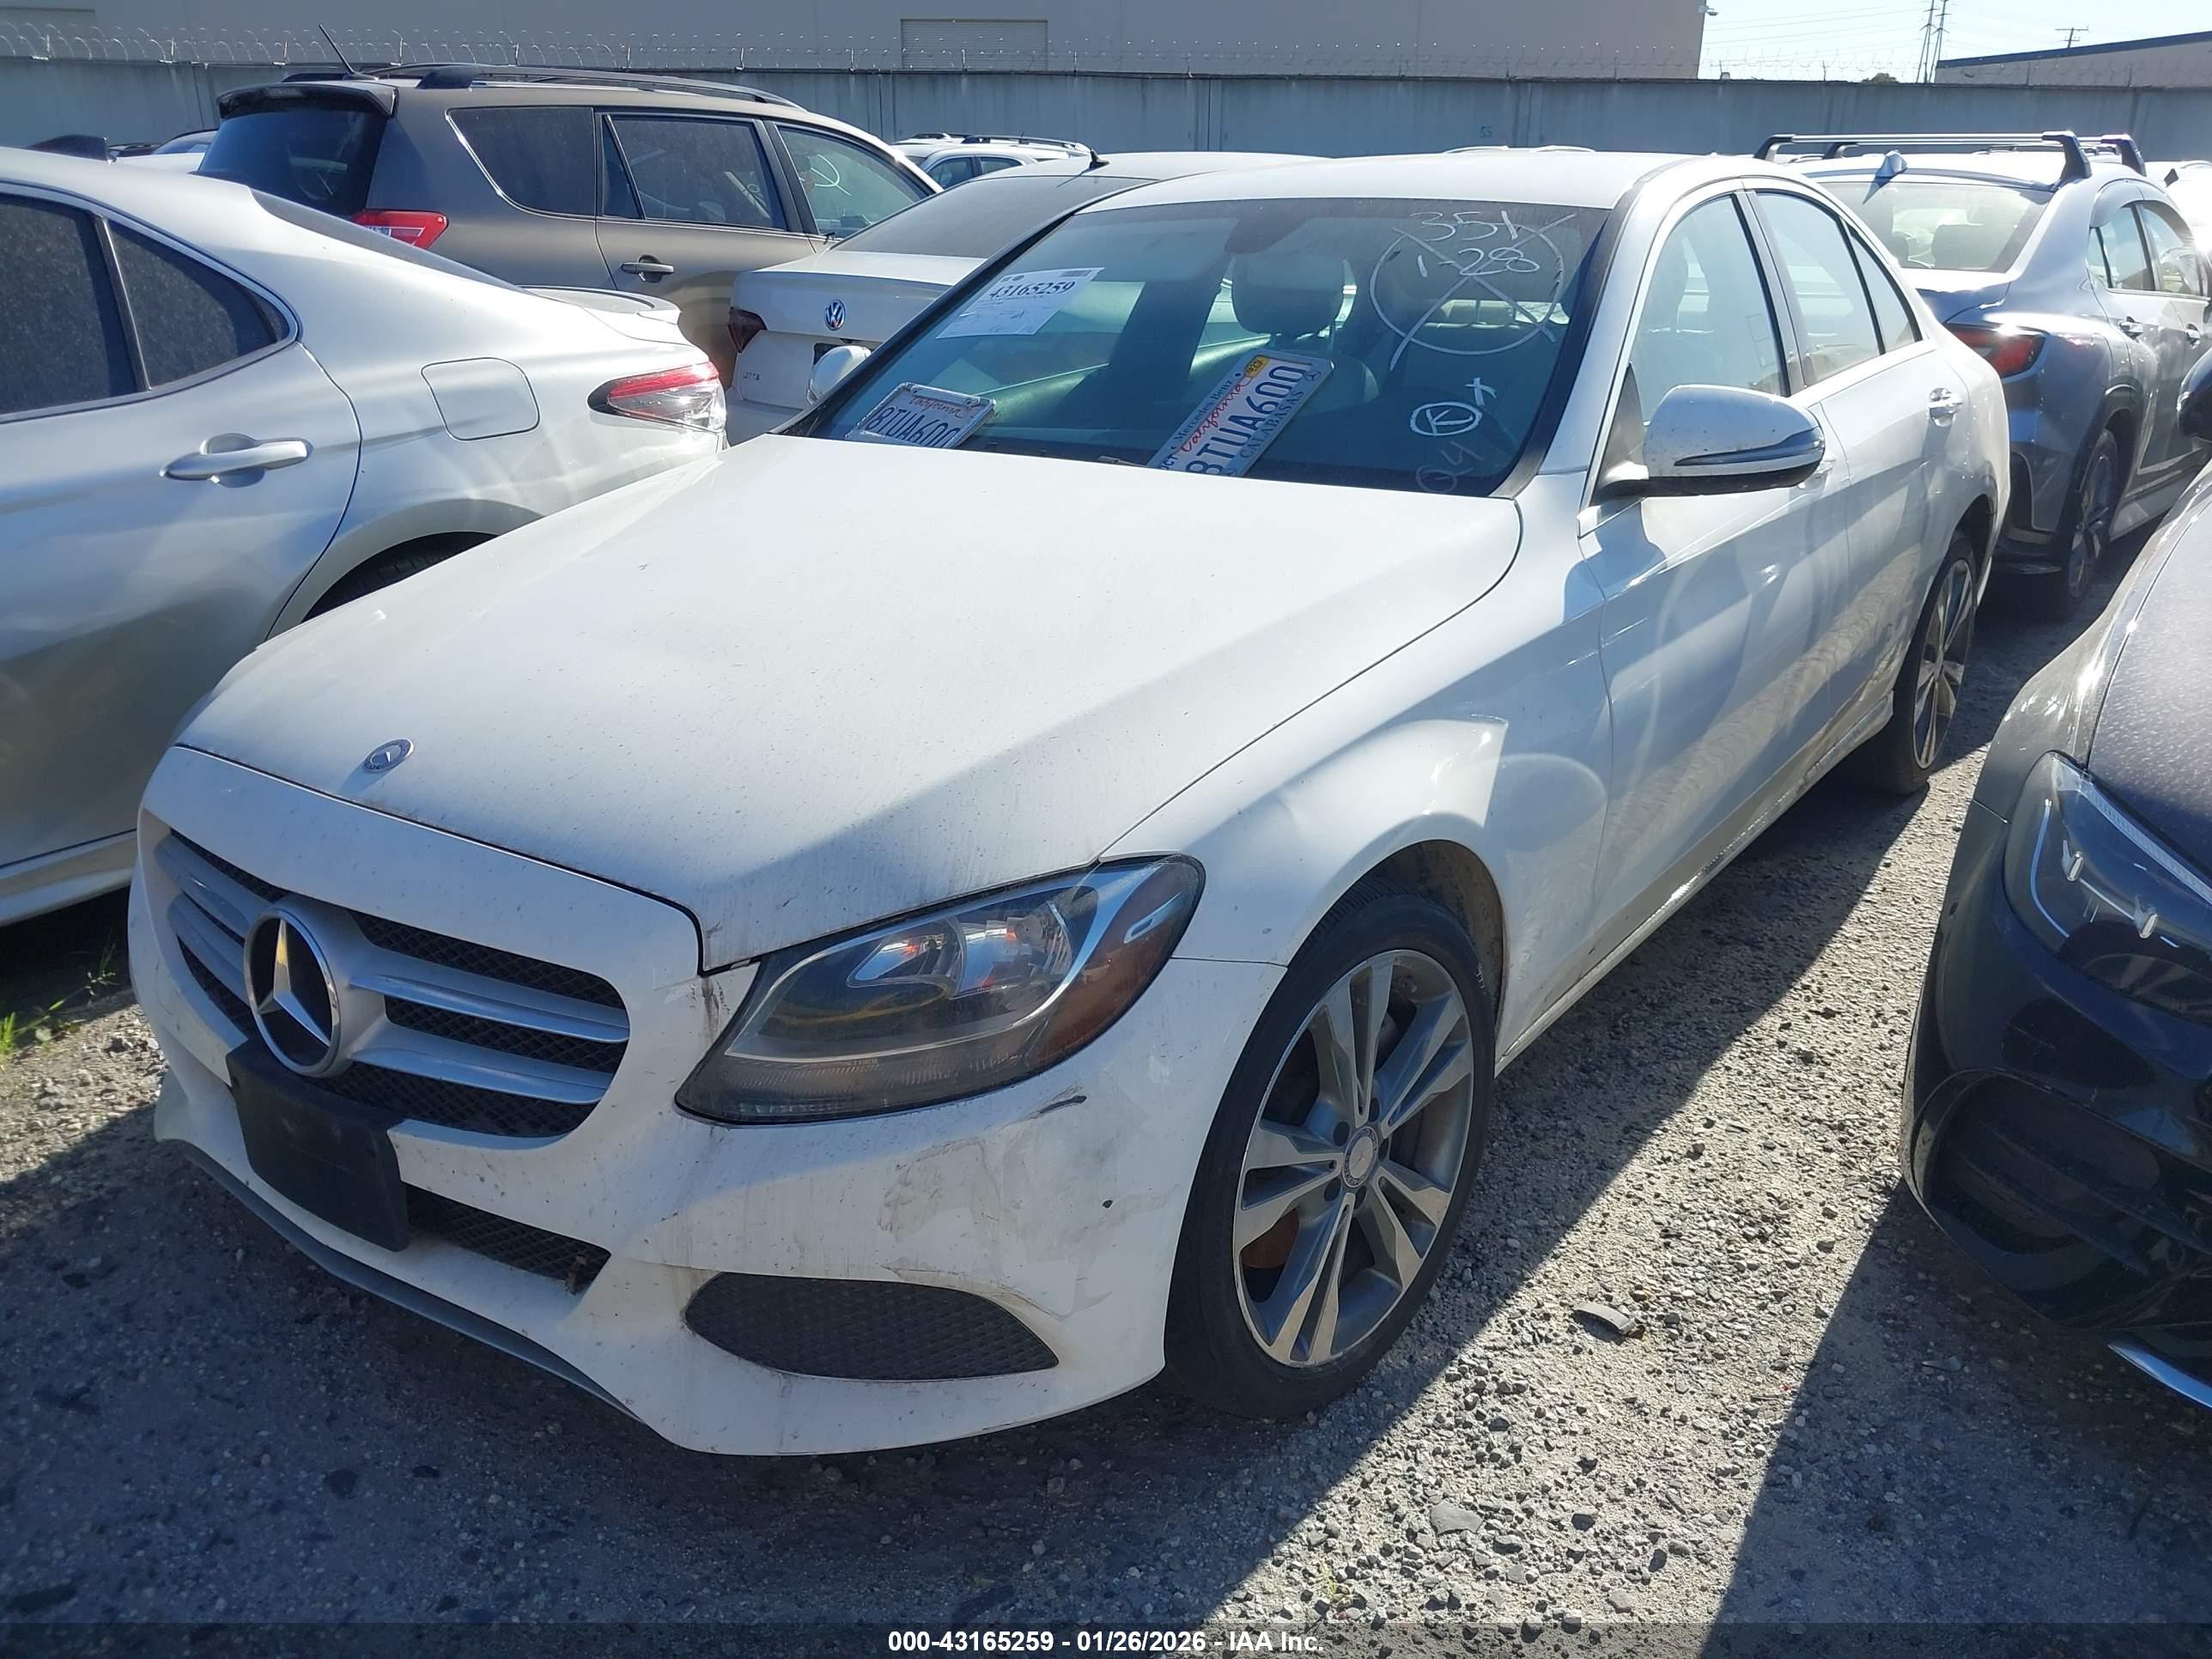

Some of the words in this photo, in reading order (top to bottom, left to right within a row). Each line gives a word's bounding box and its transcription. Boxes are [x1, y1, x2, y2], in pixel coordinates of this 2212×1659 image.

[989, 282, 1075, 298] 43165259
[866, 405, 961, 448] 8TUA600
[1182, 375, 1252, 453] California
[1185, 365, 1306, 474] 8TUA600
[1240, 390, 1304, 459] CALABASAS
